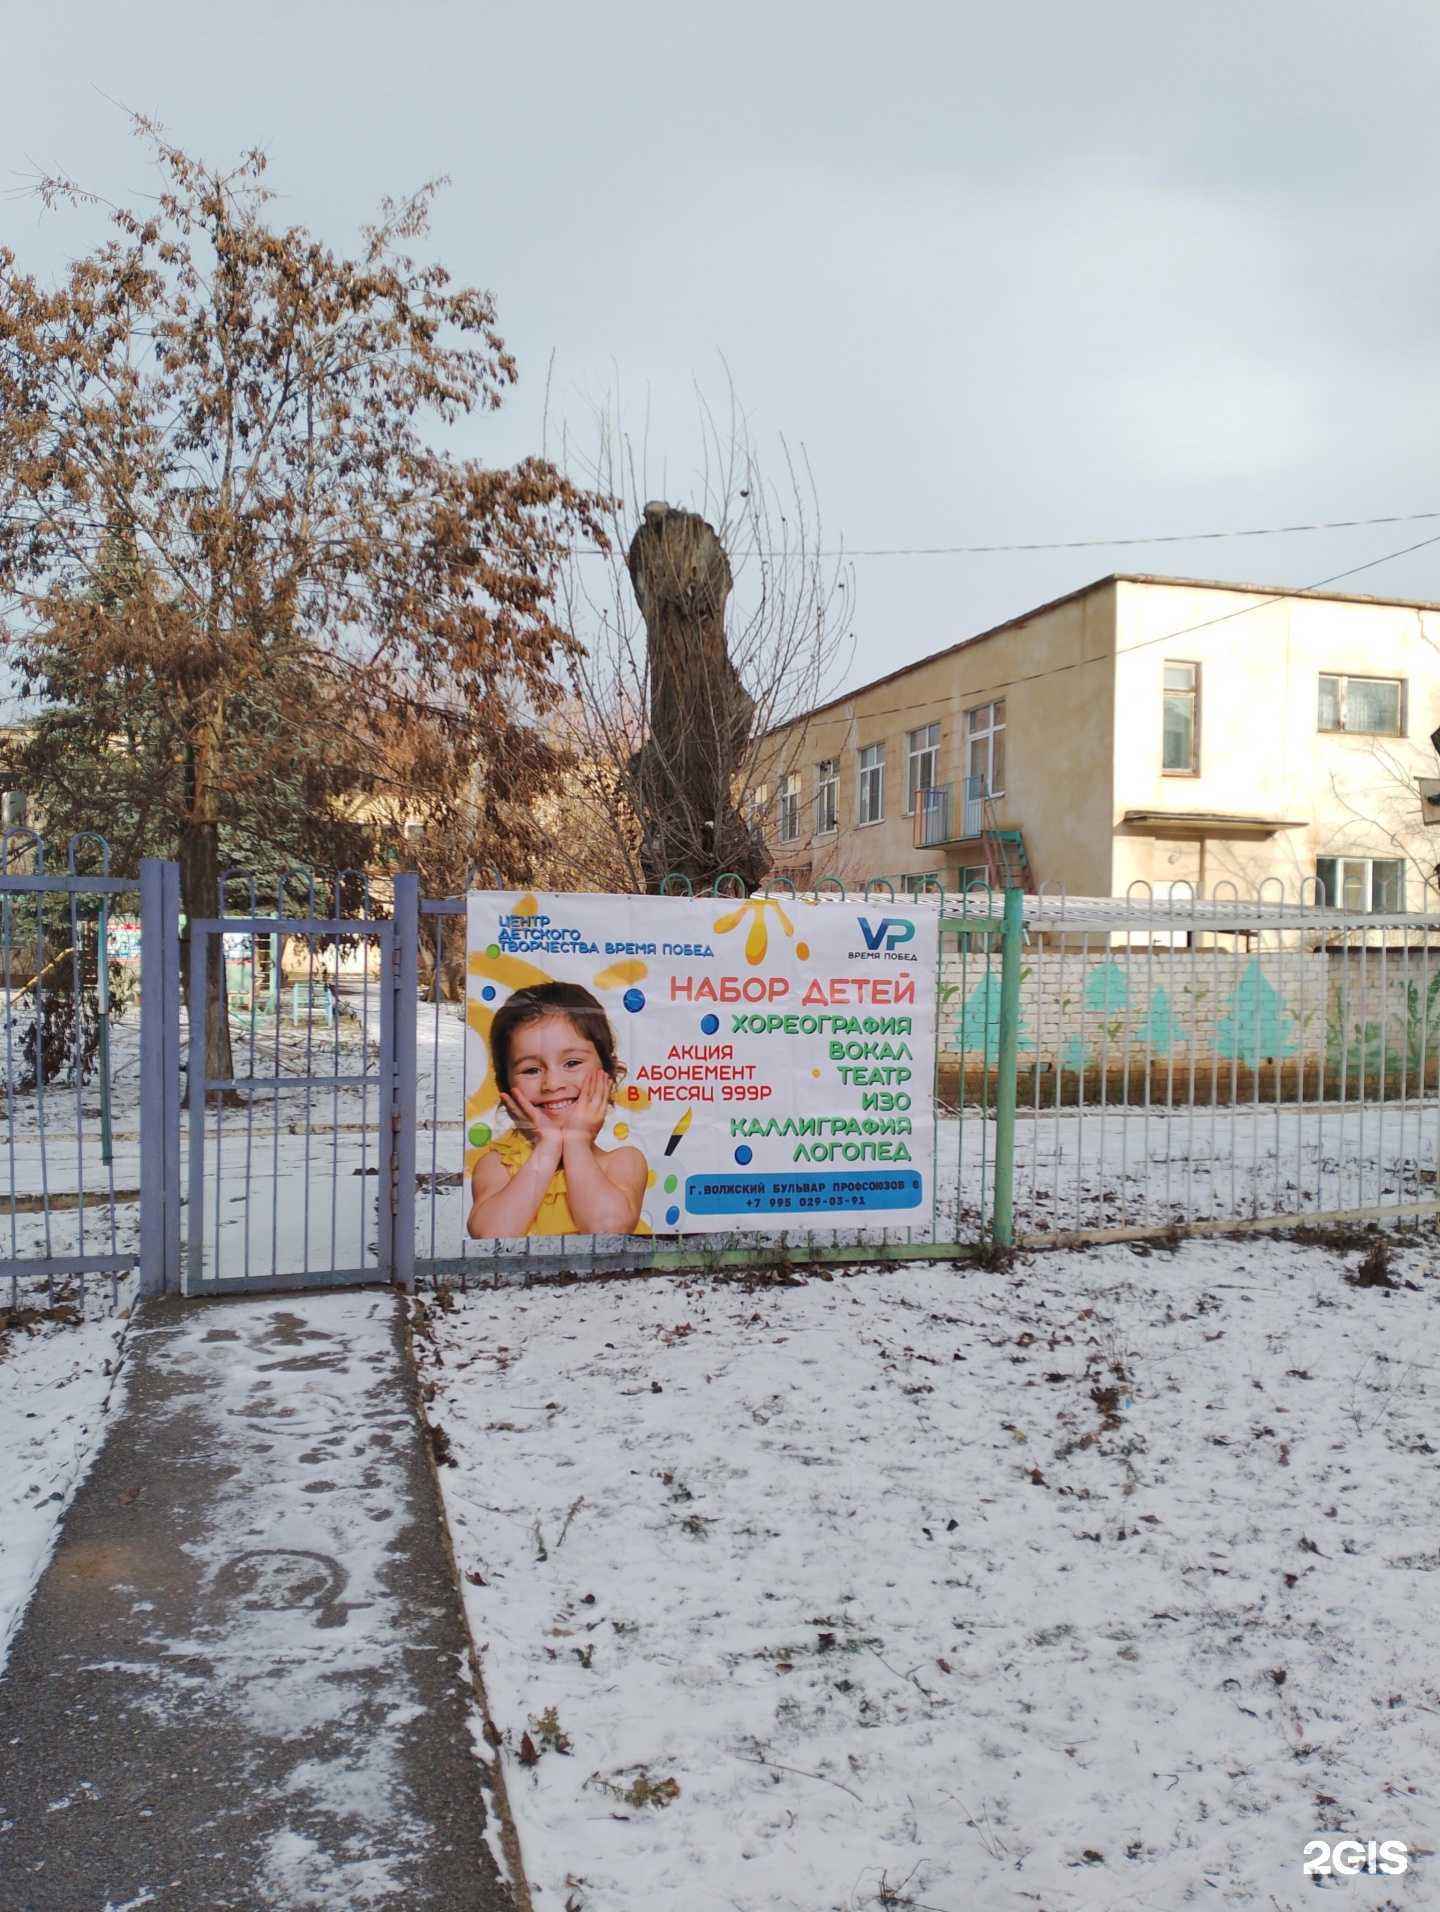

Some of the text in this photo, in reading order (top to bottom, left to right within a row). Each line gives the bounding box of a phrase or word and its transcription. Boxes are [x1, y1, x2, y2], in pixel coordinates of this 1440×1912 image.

[499, 915, 550, 928] ЦЕНТР
[498, 928, 581, 941] ДЕТСКОГО
[500, 941, 714, 957] ТВОРЧЕСТВА ВРЕМЯ ПОБЕД
[848, 952, 918, 961] ВРЕМЯ ПОБЕД
[670, 972, 916, 1006] НАБОР ДЕТЕЙ
[731, 1014, 912, 1035] ХОРЕОГРАФИЯ
[668, 1045, 733, 1061] АКЦИЯ
[829, 1041, 913, 1060] ВОКАЛ
[637, 1066, 757, 1081] АБОНЕМЕНТ
[837, 1066, 912, 1085] ТЕАТР
[627, 1086, 772, 1102] В МЕСЯЦ 999Р
[862, 1092, 912, 1111] ИЗО
[731, 1117, 912, 1137] КАЛЛИГРАФИЯ
[793, 1141, 912, 1162] ЛОГОПЕД
[773, 1184, 826, 1194] БУЛЬВАР
[746, 1199, 761, 1208] +7
[769, 1198, 792, 1208] 995
